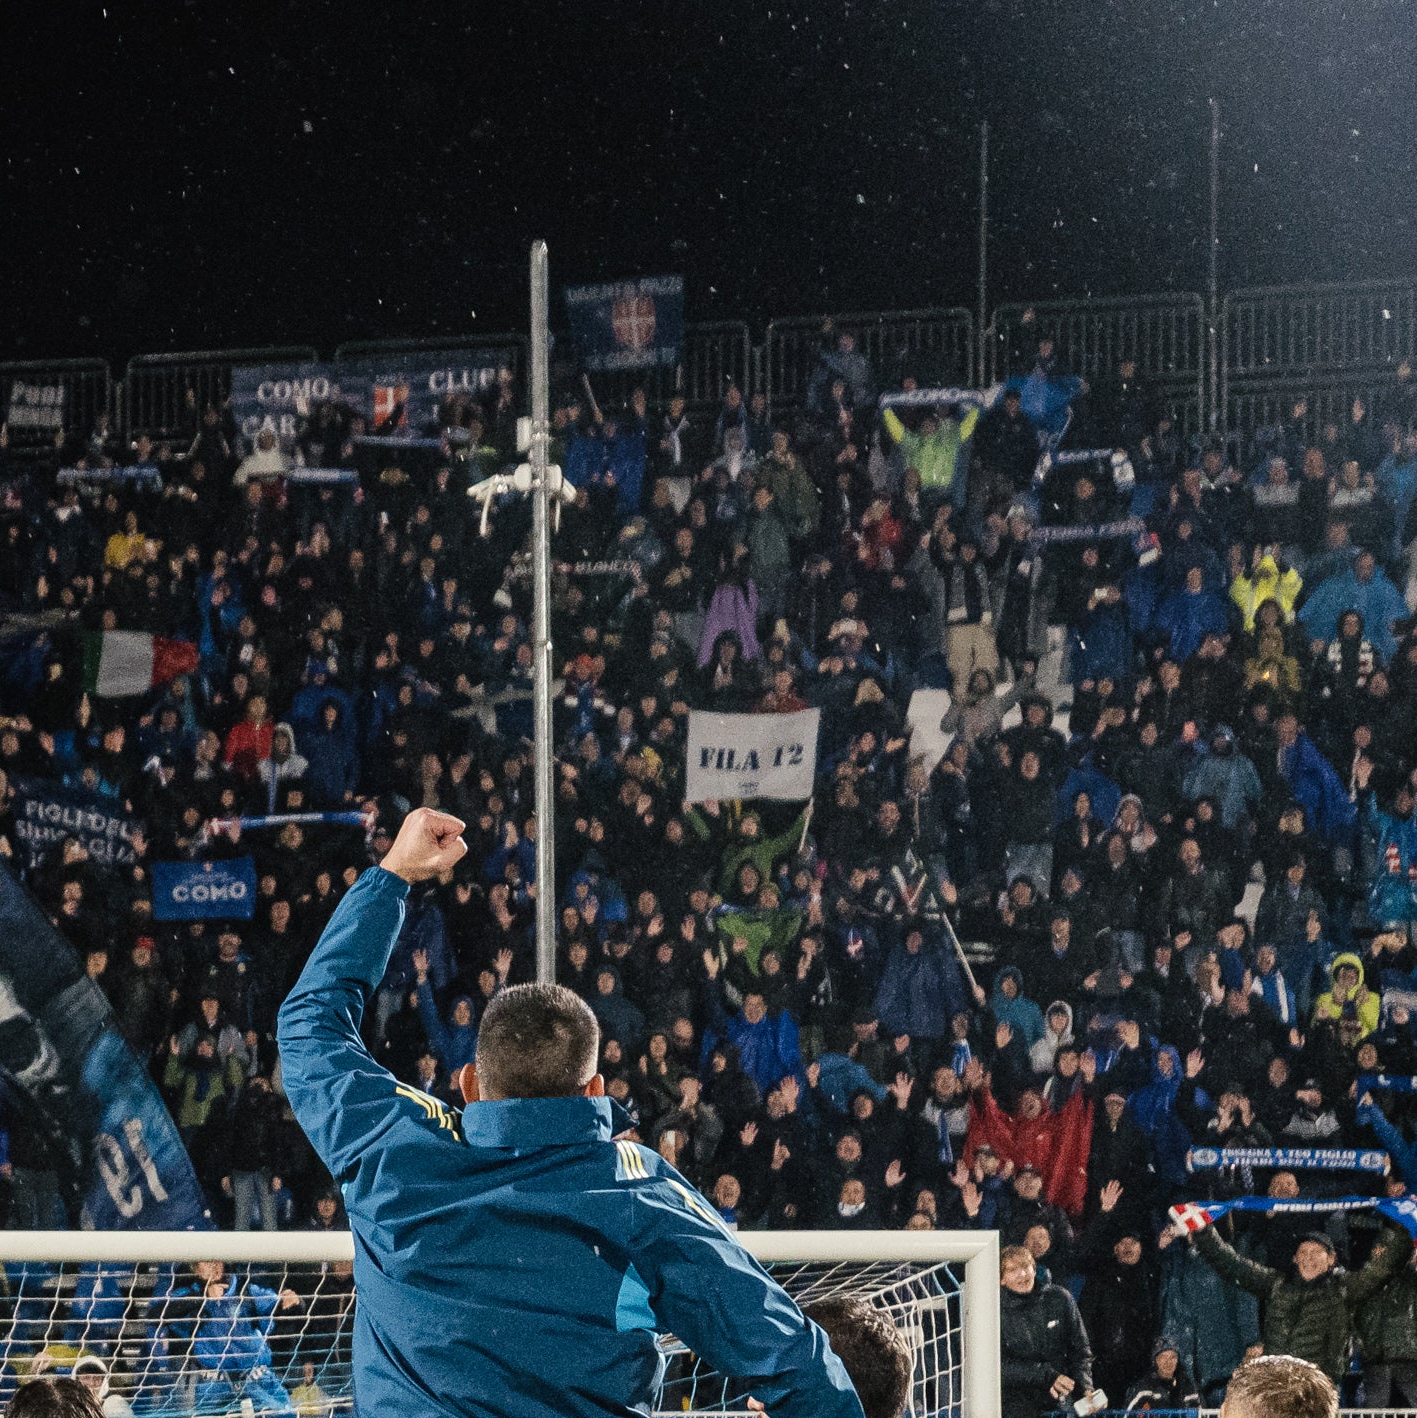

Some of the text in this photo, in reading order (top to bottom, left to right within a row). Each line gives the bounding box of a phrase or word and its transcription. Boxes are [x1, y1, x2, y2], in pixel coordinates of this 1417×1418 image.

[699, 743, 805, 771] FILA 12
[172, 880, 248, 902] COMO
